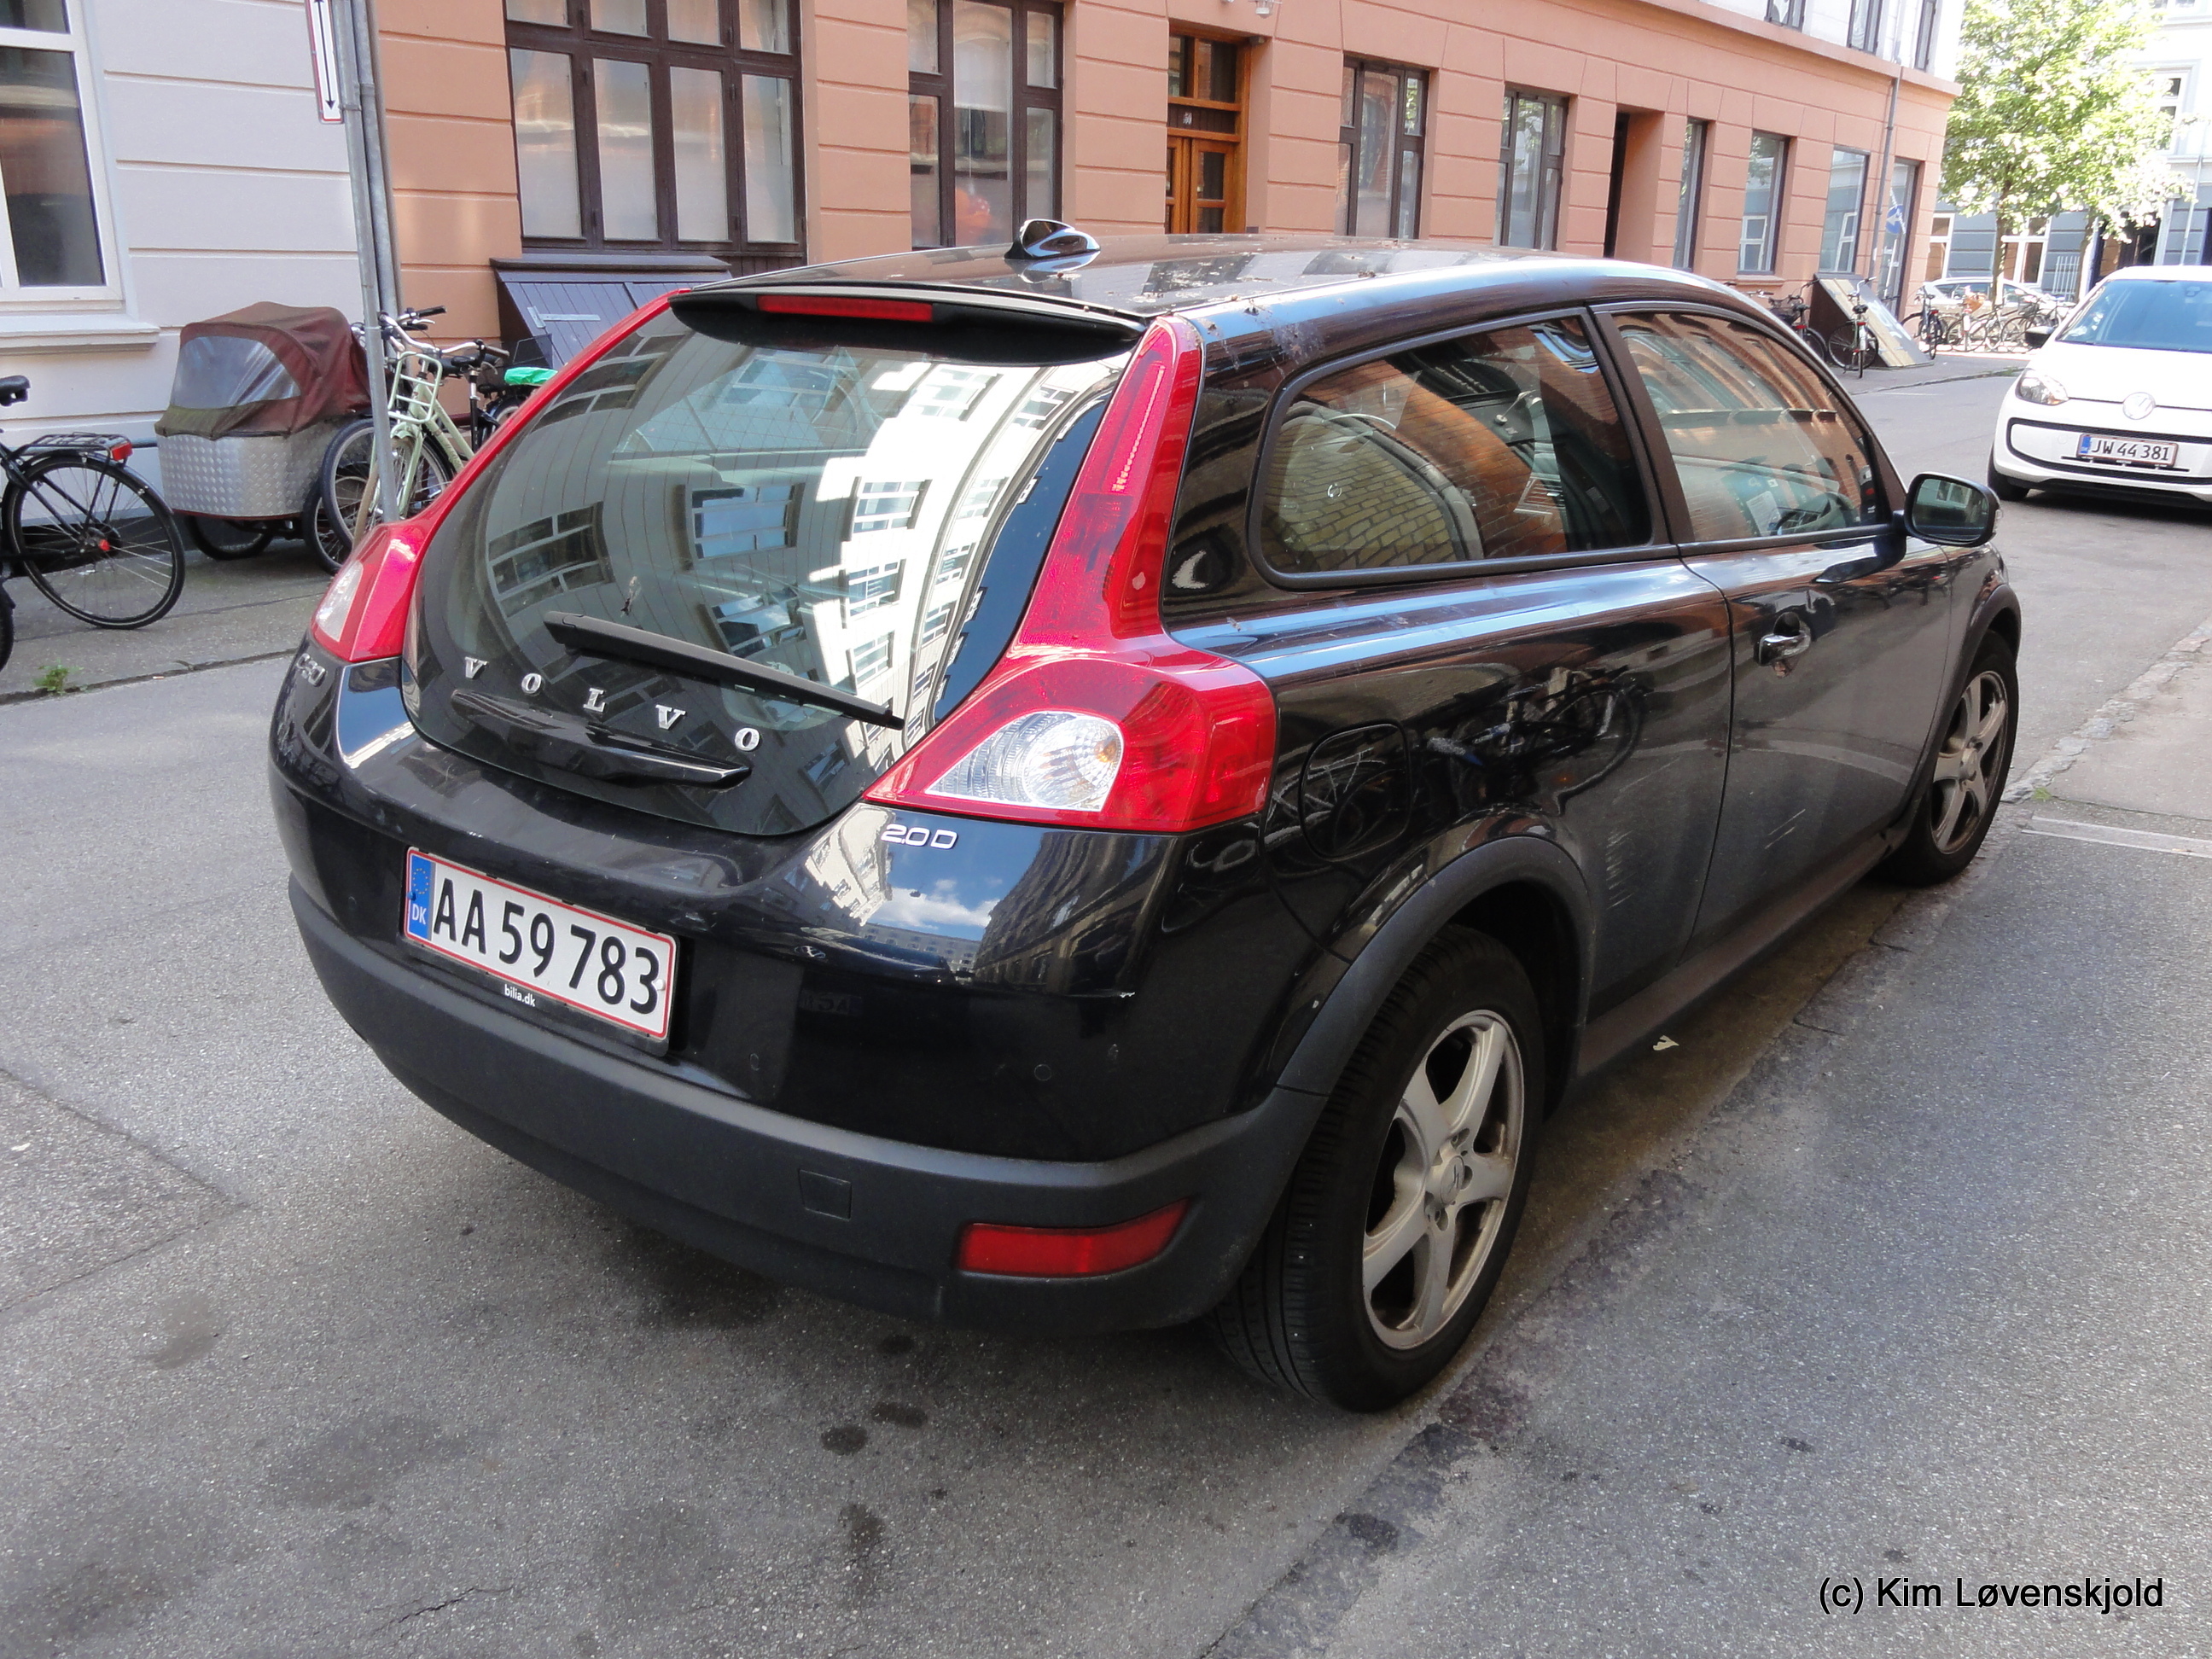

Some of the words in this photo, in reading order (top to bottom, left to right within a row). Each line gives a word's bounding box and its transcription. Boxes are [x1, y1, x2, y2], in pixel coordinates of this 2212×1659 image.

[2091, 439, 2115, 455] JW
[2116, 442, 2138, 457] 44
[2140, 445, 2170, 461] 381
[463, 656, 762, 752] VOLVO
[411, 903, 427, 926] DK
[433, 877, 487, 955] AA
[498, 899, 556, 978] 59
[568, 923, 661, 1015] 783
[504, 983, 536, 1007] bilia.dk
